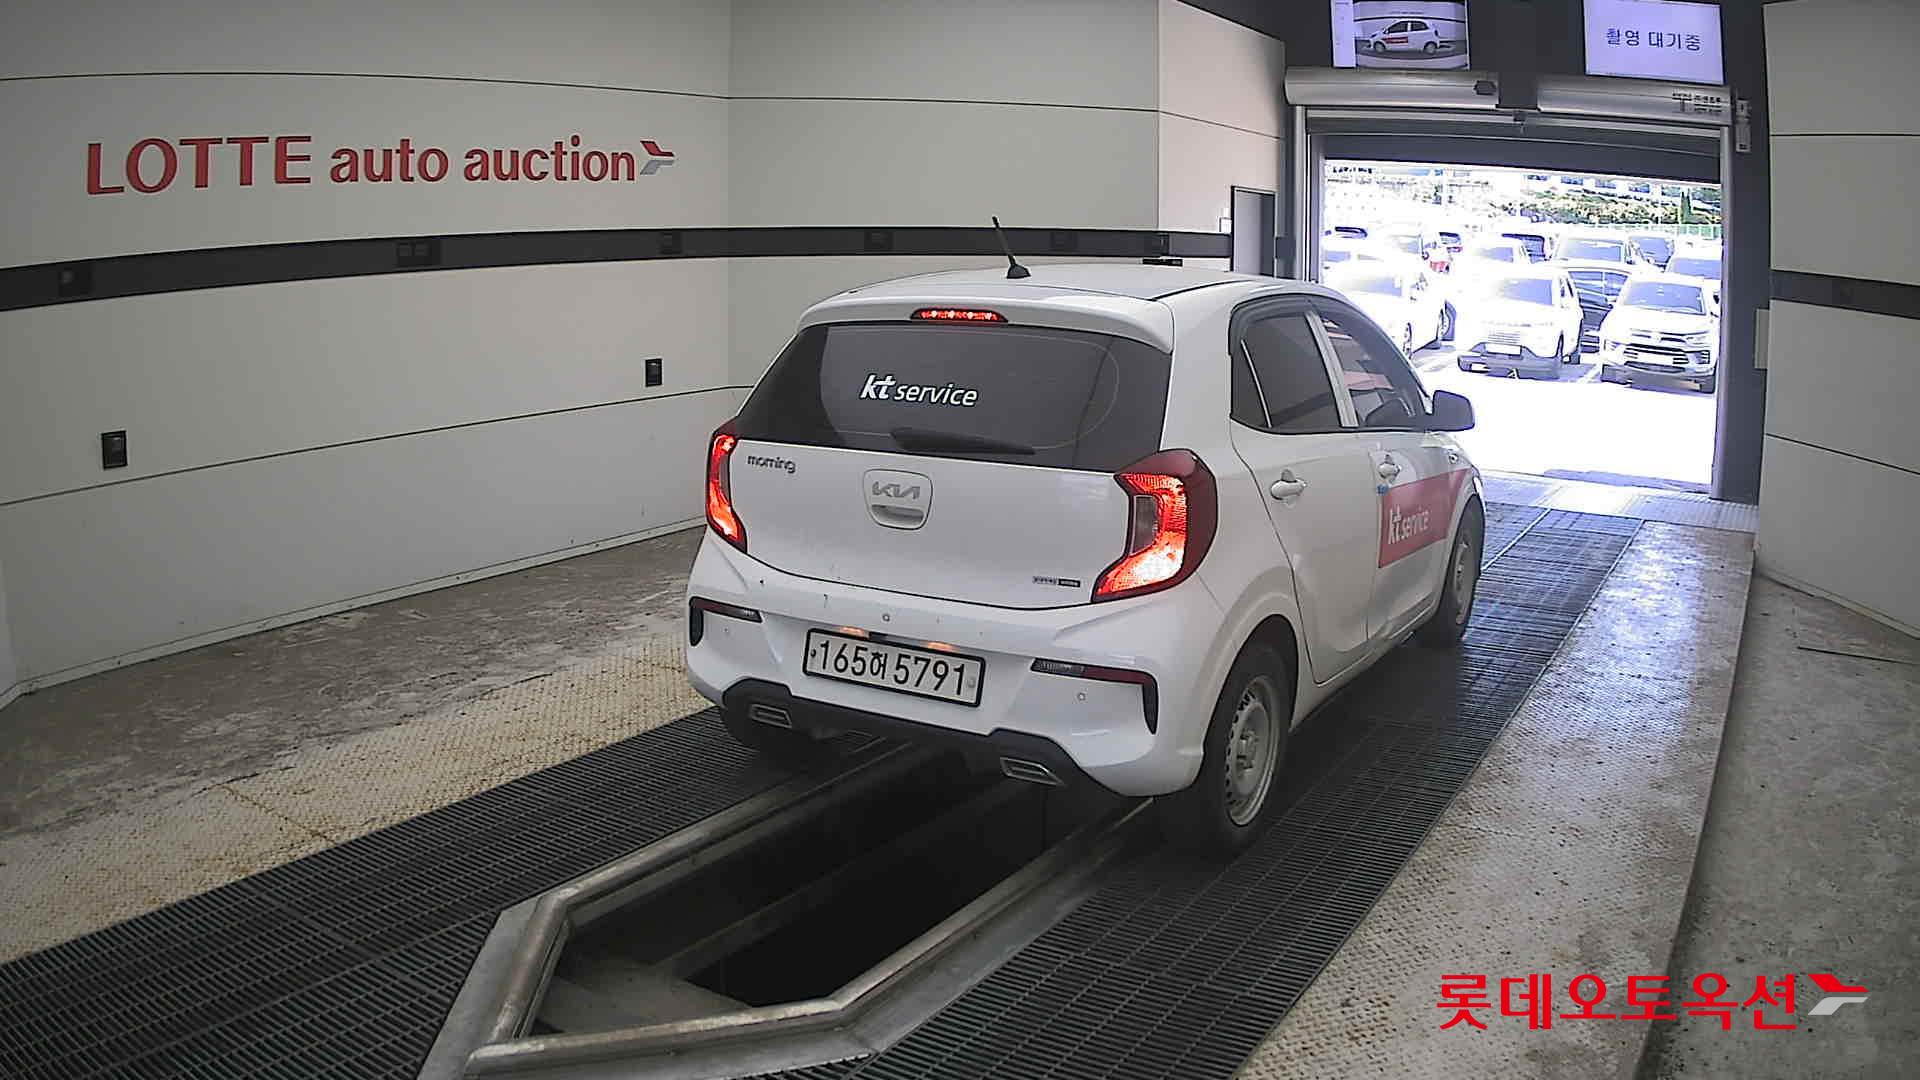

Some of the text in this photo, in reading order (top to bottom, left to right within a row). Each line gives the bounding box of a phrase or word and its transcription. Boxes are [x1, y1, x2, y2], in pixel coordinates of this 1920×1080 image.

[1606, 28, 1701, 51] 촬영 대기중
[86, 134, 636, 195] LOTTE auto auction
[860, 374, 979, 407] kt service
[747, 454, 797, 474] morning
[1387, 505, 1430, 545] kt service
